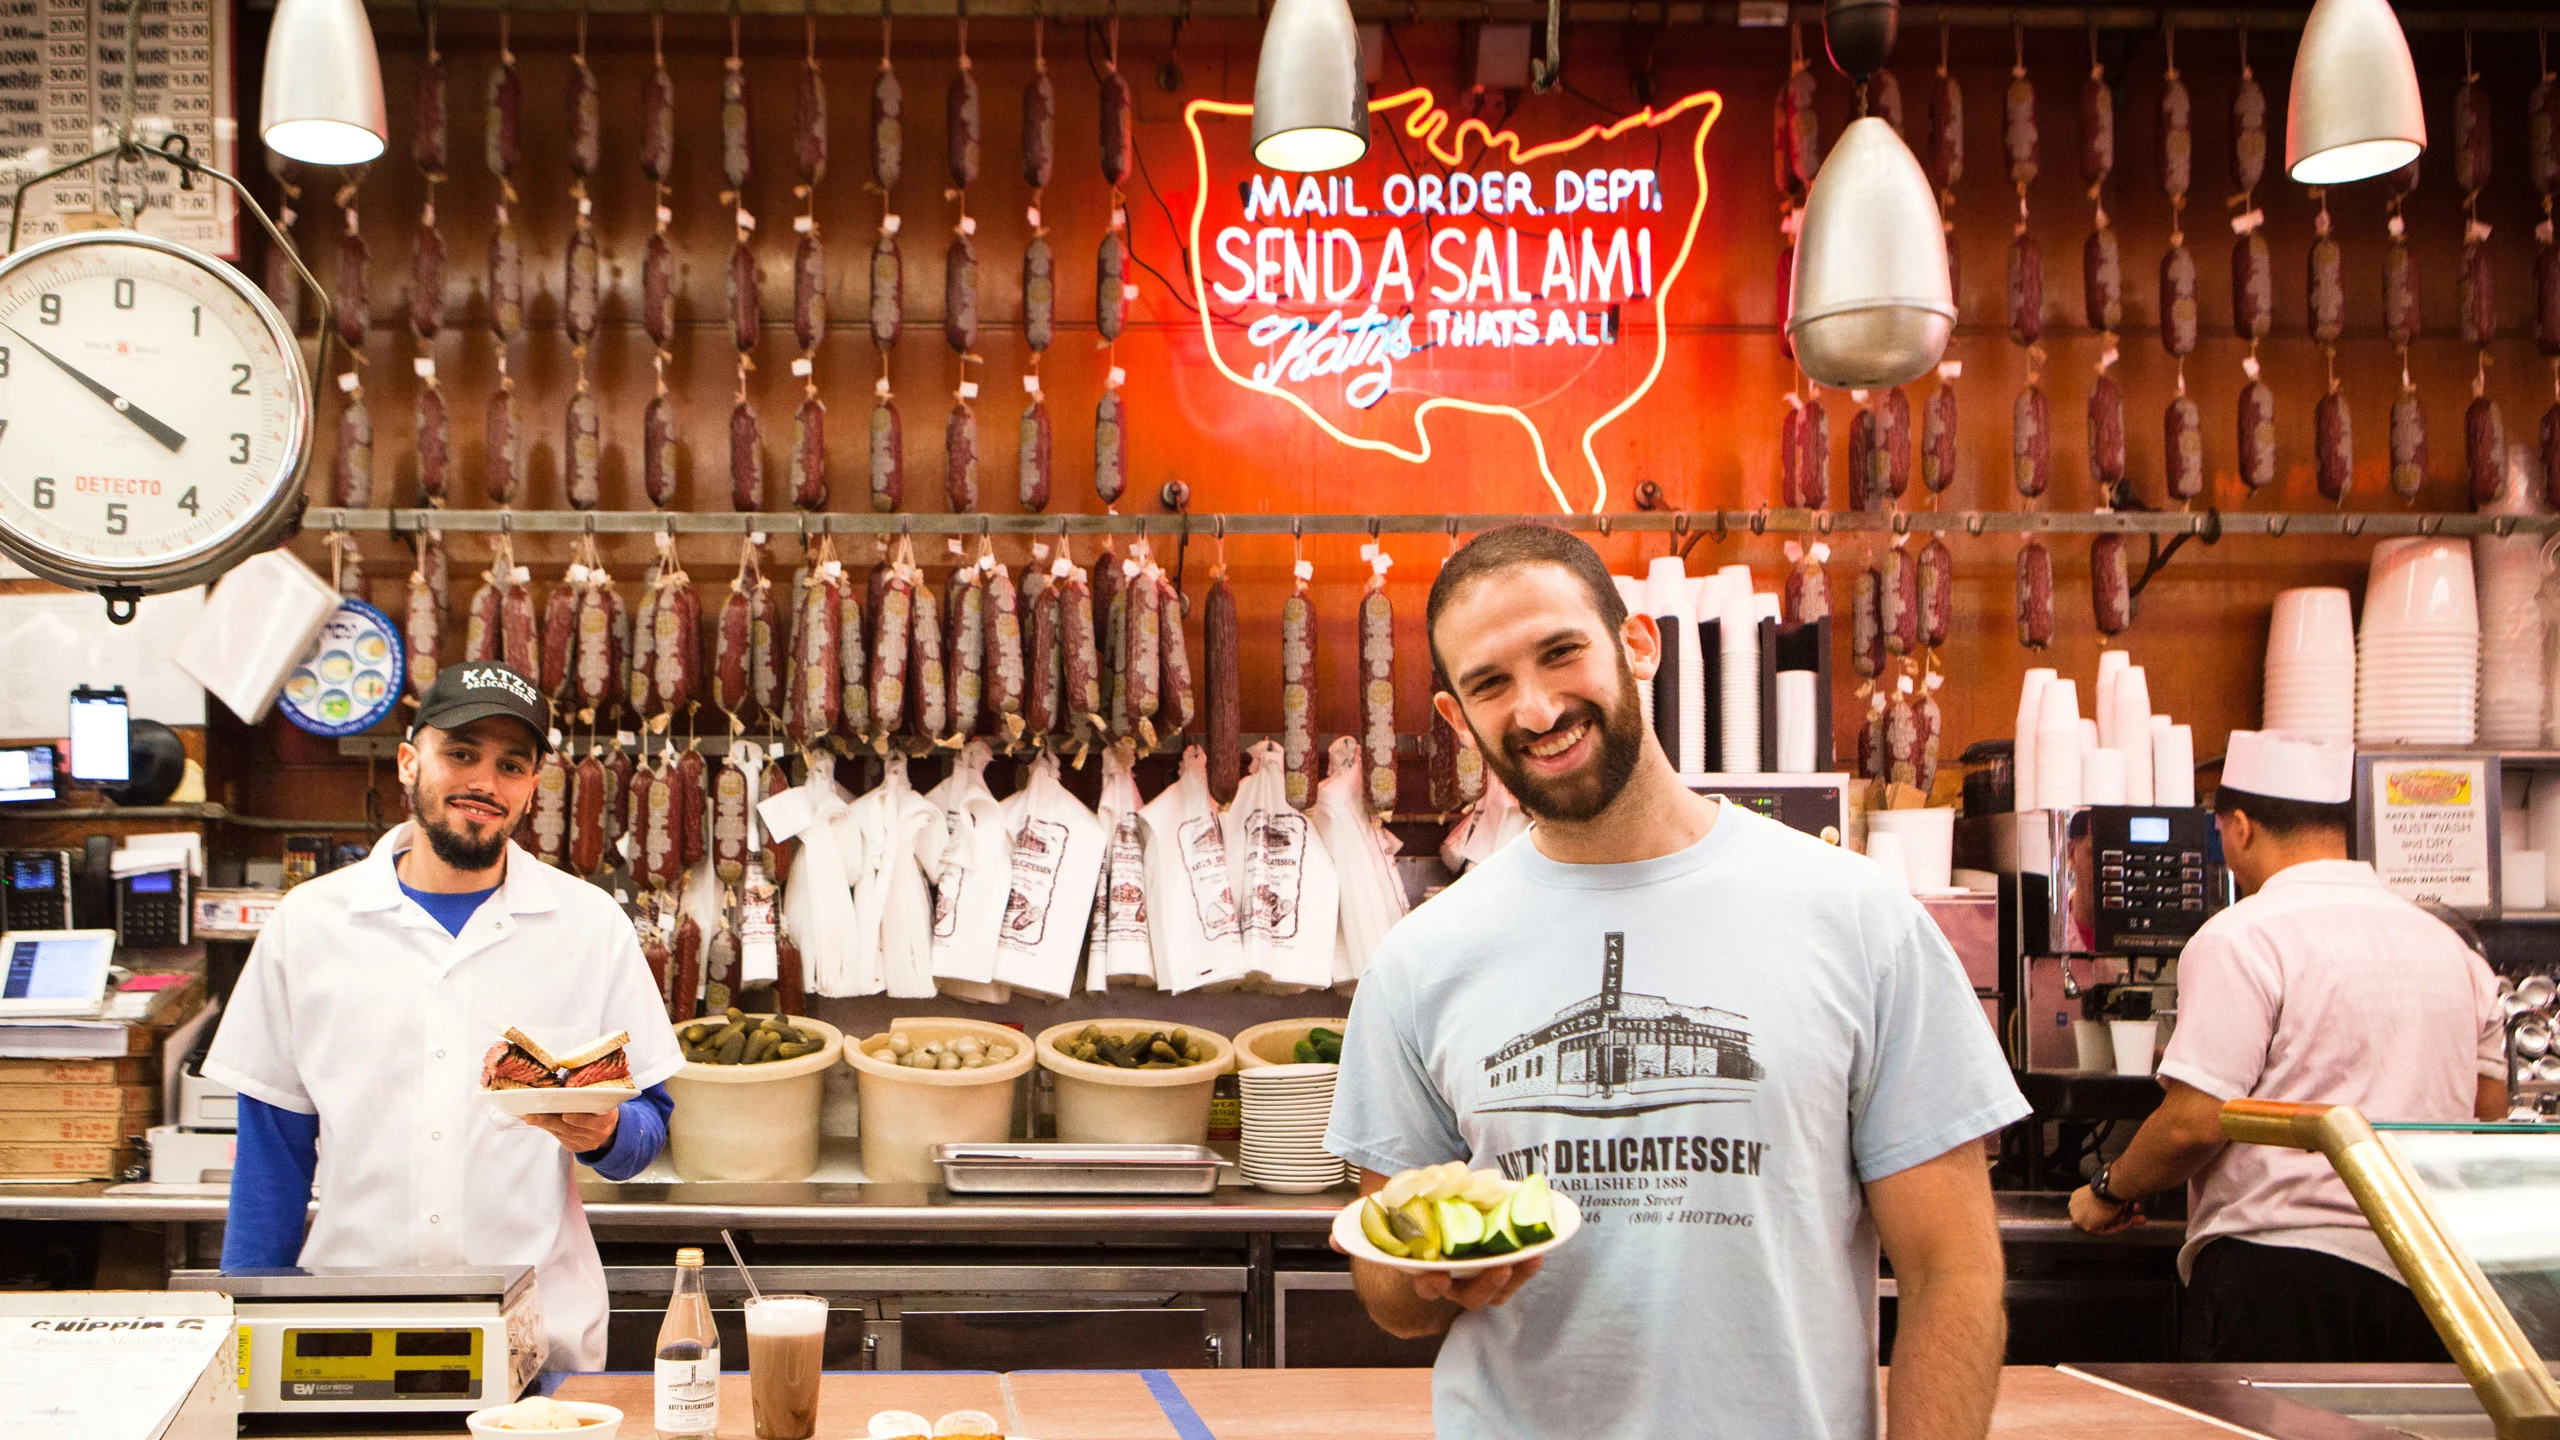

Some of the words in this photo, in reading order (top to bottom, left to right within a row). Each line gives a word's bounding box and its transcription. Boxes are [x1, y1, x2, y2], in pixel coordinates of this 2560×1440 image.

[1213, 226, 1363, 304] SEND
[1371, 227, 1415, 303] A
[1430, 226, 1652, 303] SALAMI
[40, 293, 61, 325] 9
[115, 278, 135, 309] 0
[192, 305, 201, 337] 1
[1544, 308, 1617, 347] ALL
[231, 363, 251, 395] 2
[229, 433, 250, 464] 3
[34, 477, 55, 510] 6
[75, 475, 162, 496] DETECTO
[178, 485, 200, 517] 4
[106, 503, 128, 535] 5
[462, 667, 538, 702] KATZ'S
[2392, 822, 2428, 834] MUST
[2433, 822, 2472, 834] WASH
[2426, 837, 2453, 849] DRY
[2408, 852, 2454, 864] HANDS
[1554, 1136, 1763, 1177] DELICATESSEN
[1655, 1176, 1689, 1190] 1888
[1579, 1194, 1642, 1207] Houston
[1643, 1193, 1684, 1207] Street
[1628, 1211, 1664, 1226] (800)
[1665, 1211, 1675, 1223] 4
[1677, 1210, 1755, 1229] HOTDOG
